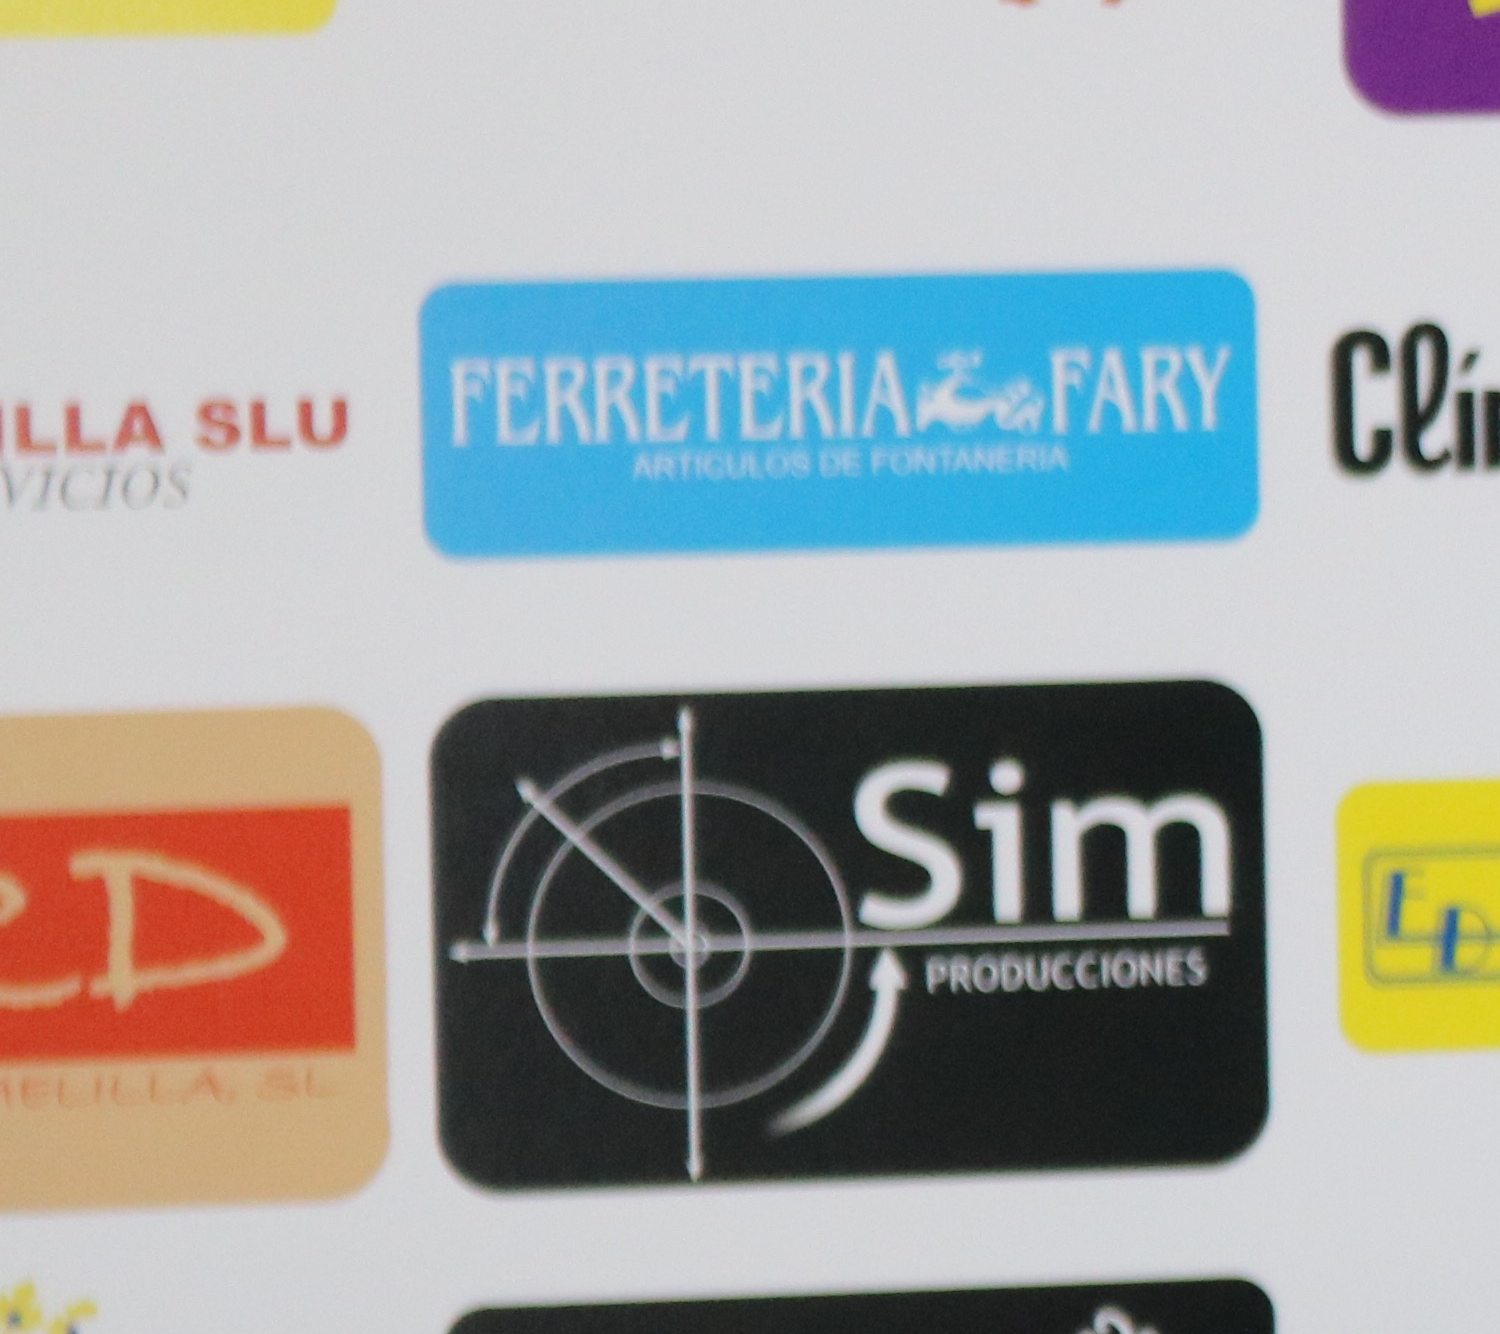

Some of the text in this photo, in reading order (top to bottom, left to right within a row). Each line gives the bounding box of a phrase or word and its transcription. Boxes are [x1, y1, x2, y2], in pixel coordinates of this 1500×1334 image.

[448, 343, 1232, 449] FERRETERIA FARY
[196, 397, 348, 451] SLU
[632, 441, 1070, 483] ARTICULOS DE FONTANERIA
[852, 757, 1234, 931] Sim
[924, 947, 1208, 995] PRODUCCIONES
